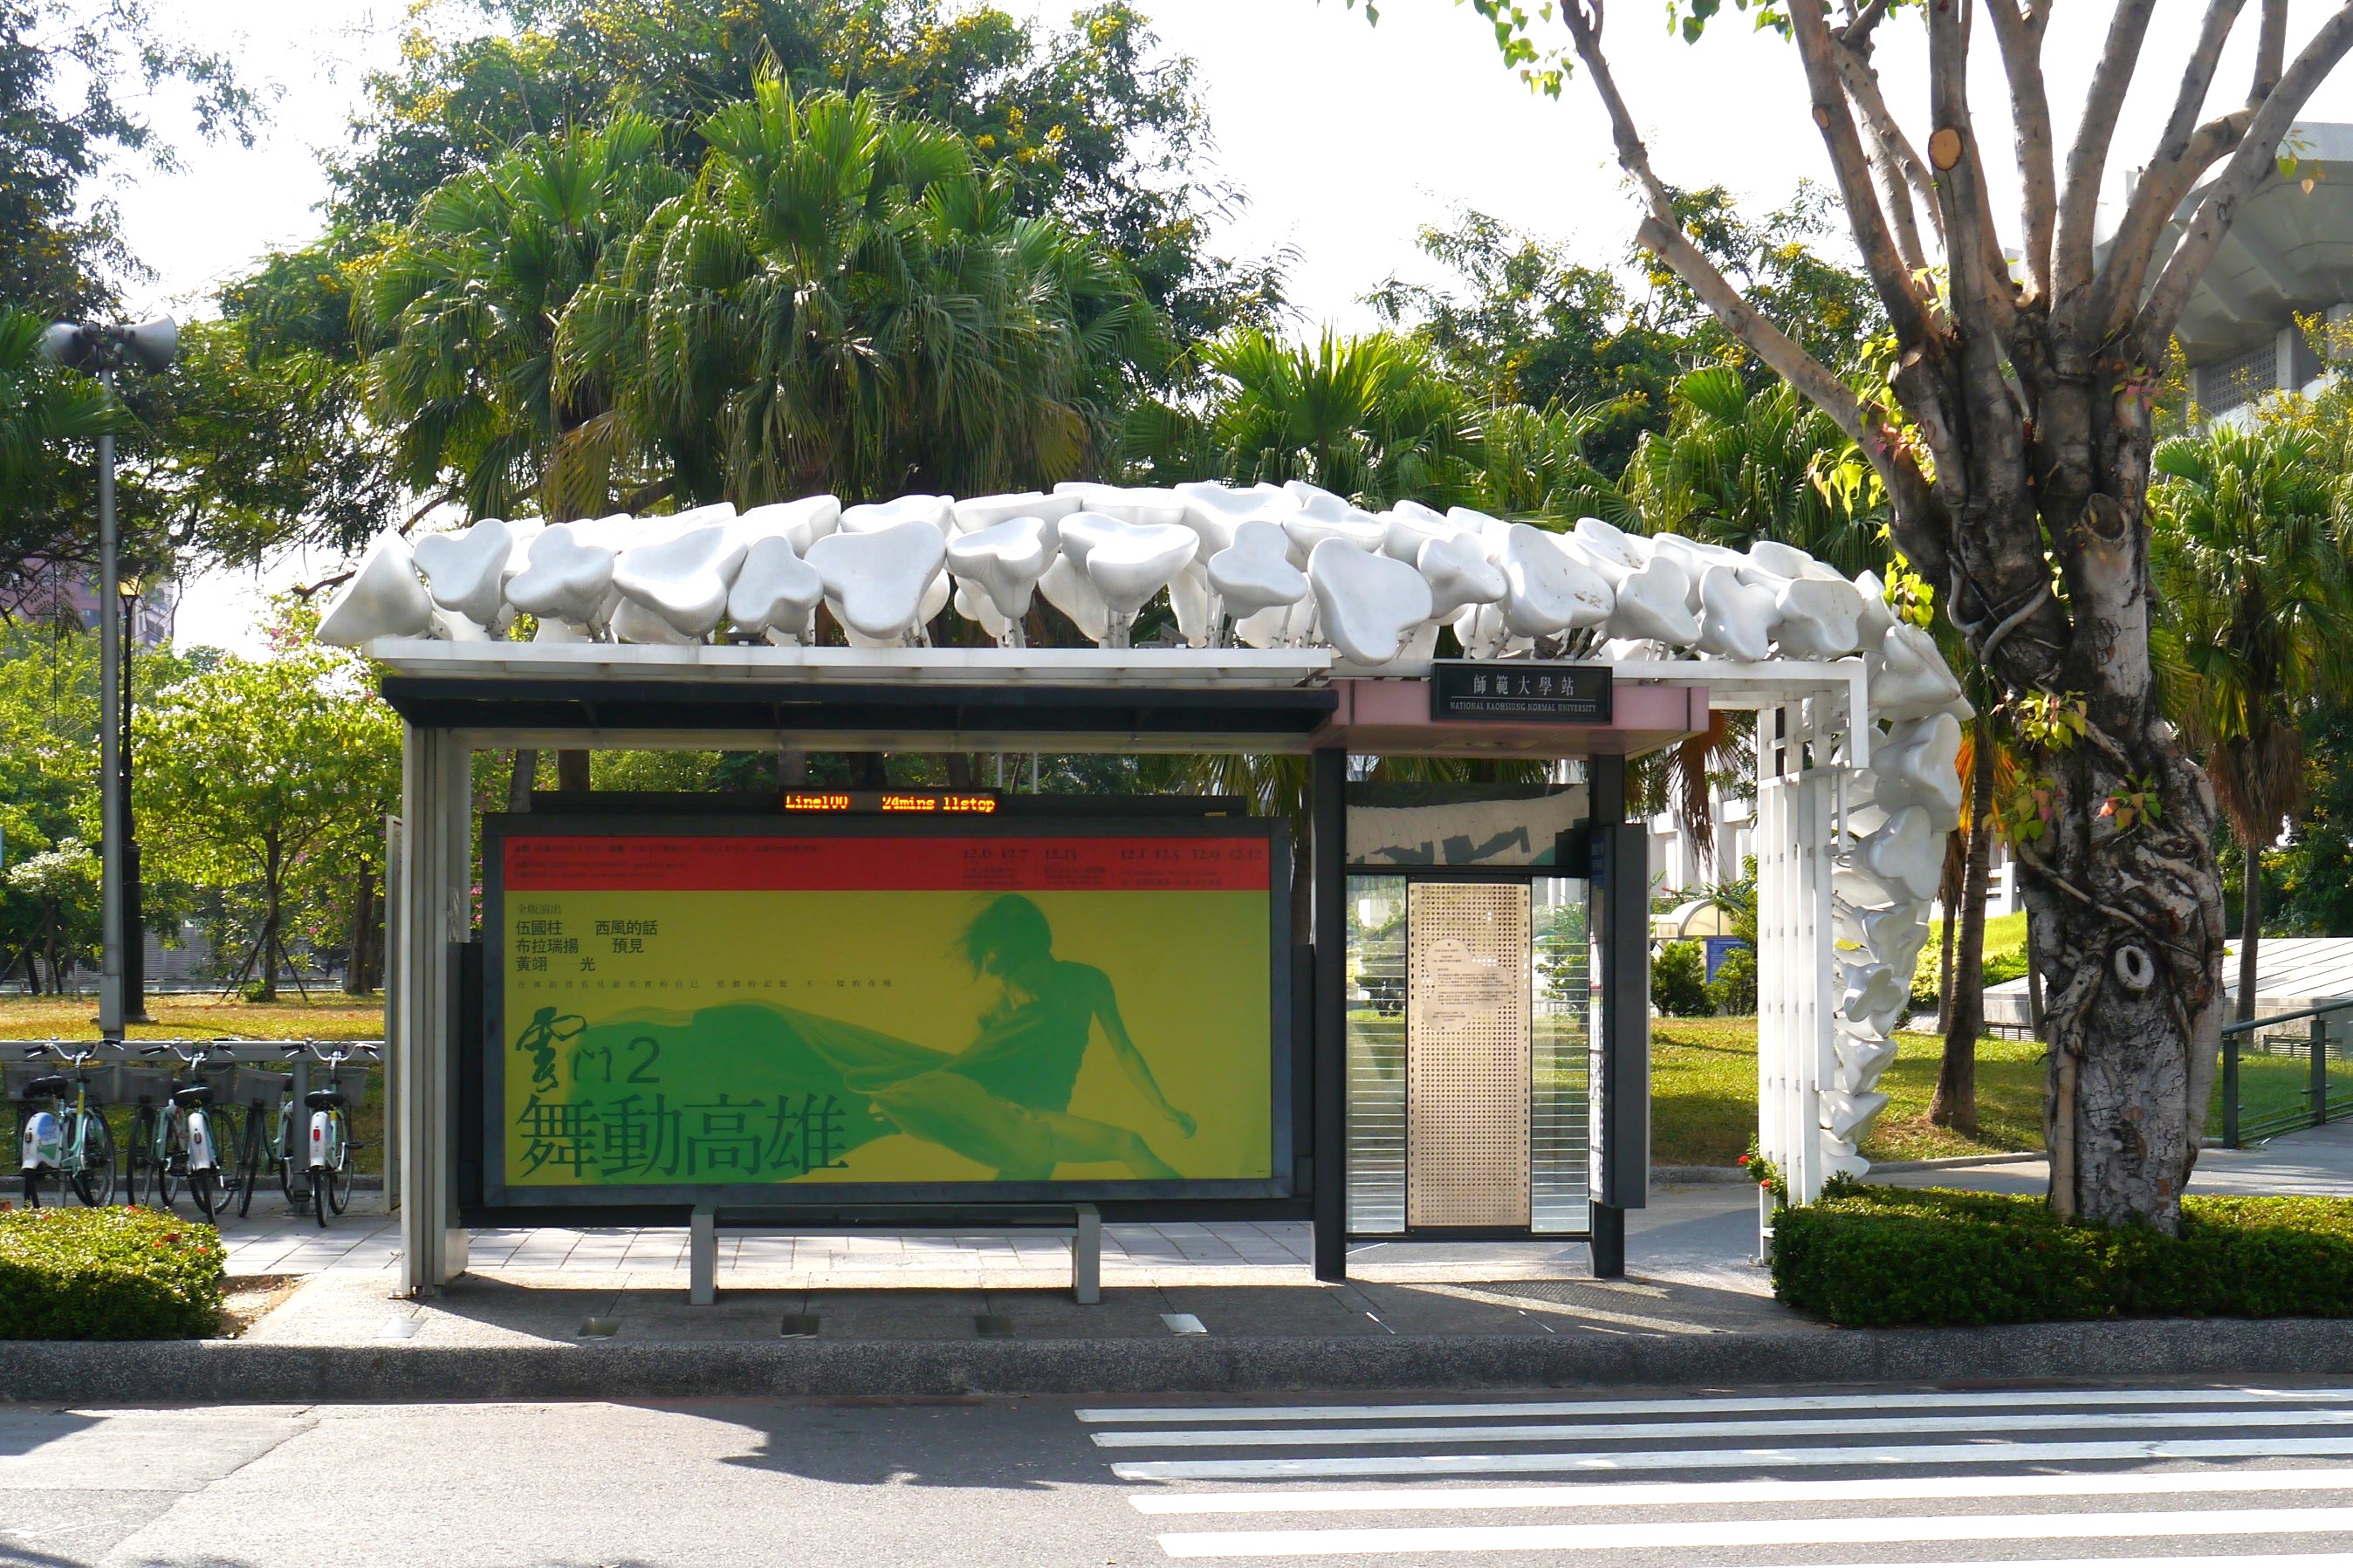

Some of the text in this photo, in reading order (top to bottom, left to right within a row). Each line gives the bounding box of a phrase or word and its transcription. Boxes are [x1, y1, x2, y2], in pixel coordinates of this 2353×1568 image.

[1473, 674, 1574, 696] 師範大學站
[1450, 702, 1597, 713] NATIONAL KAOHSIUNG NORMAL UNIVERSITY
[516, 921, 658, 935] 伍國柱 西風的話
[516, 938, 644, 954] 布拉瑞揚 預見
[516, 956, 595, 971] 黃翊 光
[516, 1092, 849, 1178] 舞動高雄
